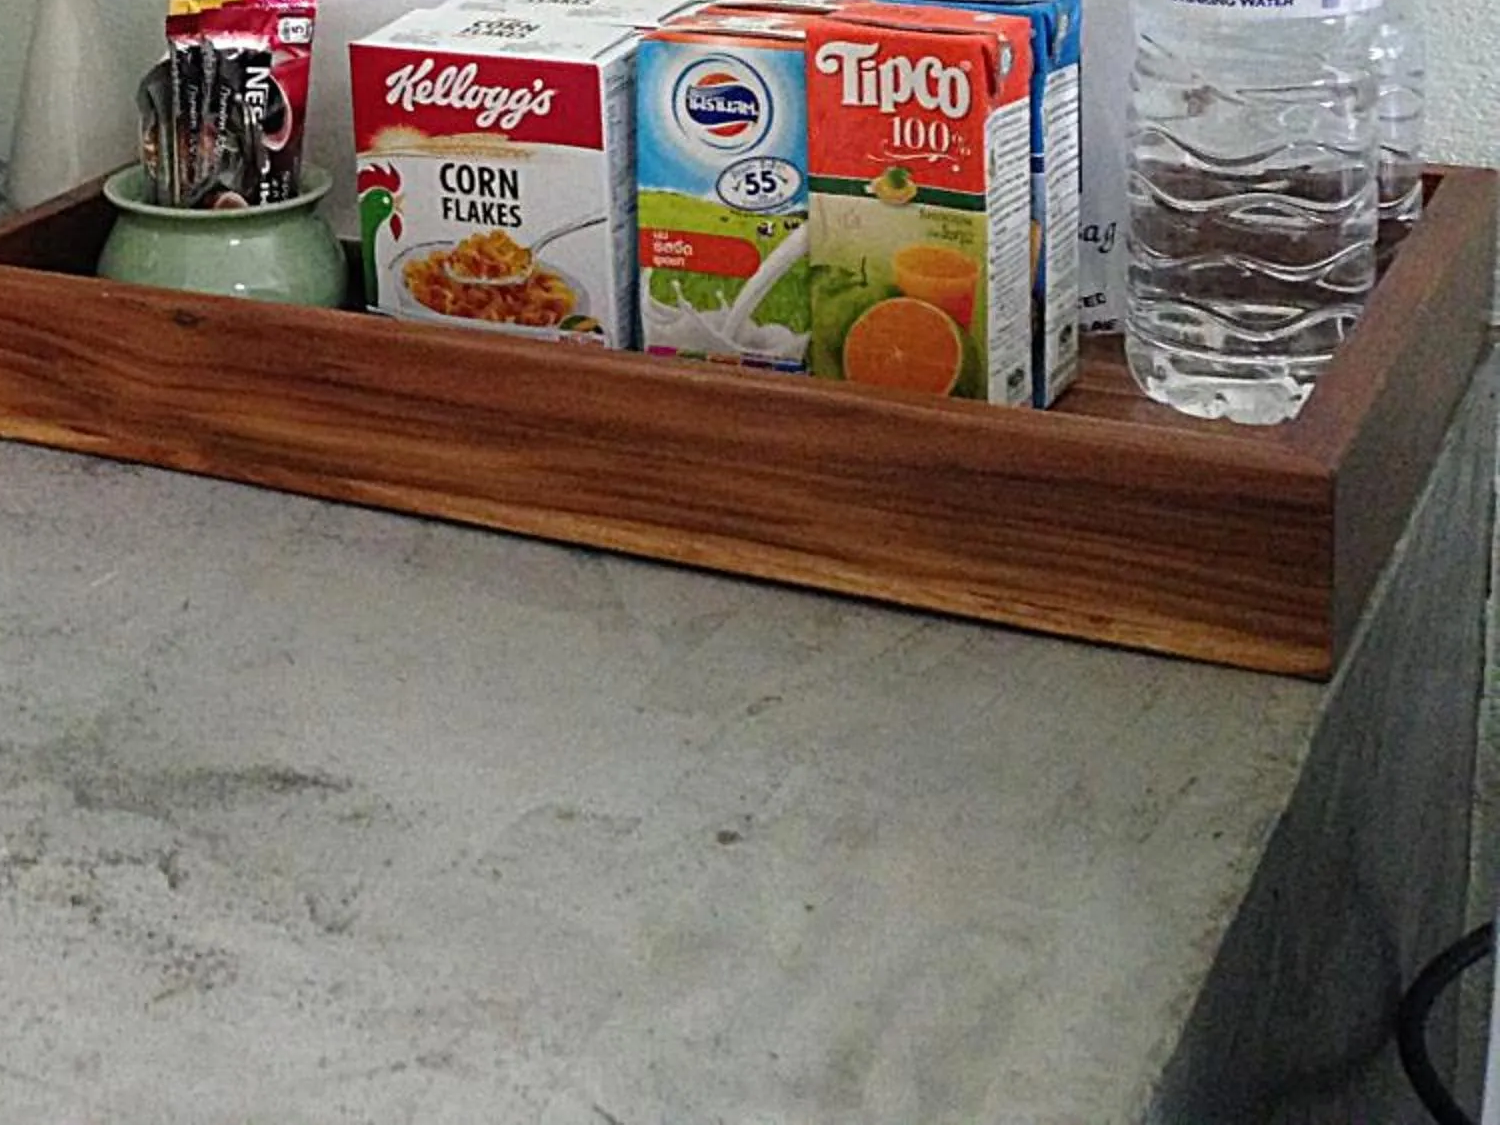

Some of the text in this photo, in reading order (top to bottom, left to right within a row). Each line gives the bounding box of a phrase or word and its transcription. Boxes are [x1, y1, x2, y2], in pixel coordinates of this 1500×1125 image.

[385, 58, 558, 130] Kellogg's
[815, 41, 971, 119] Tipco
[891, 116, 971, 156] 100%
[439, 163, 519, 200] CORN
[745, 170, 778, 196] 55
[441, 197, 523, 229] FLAKES
